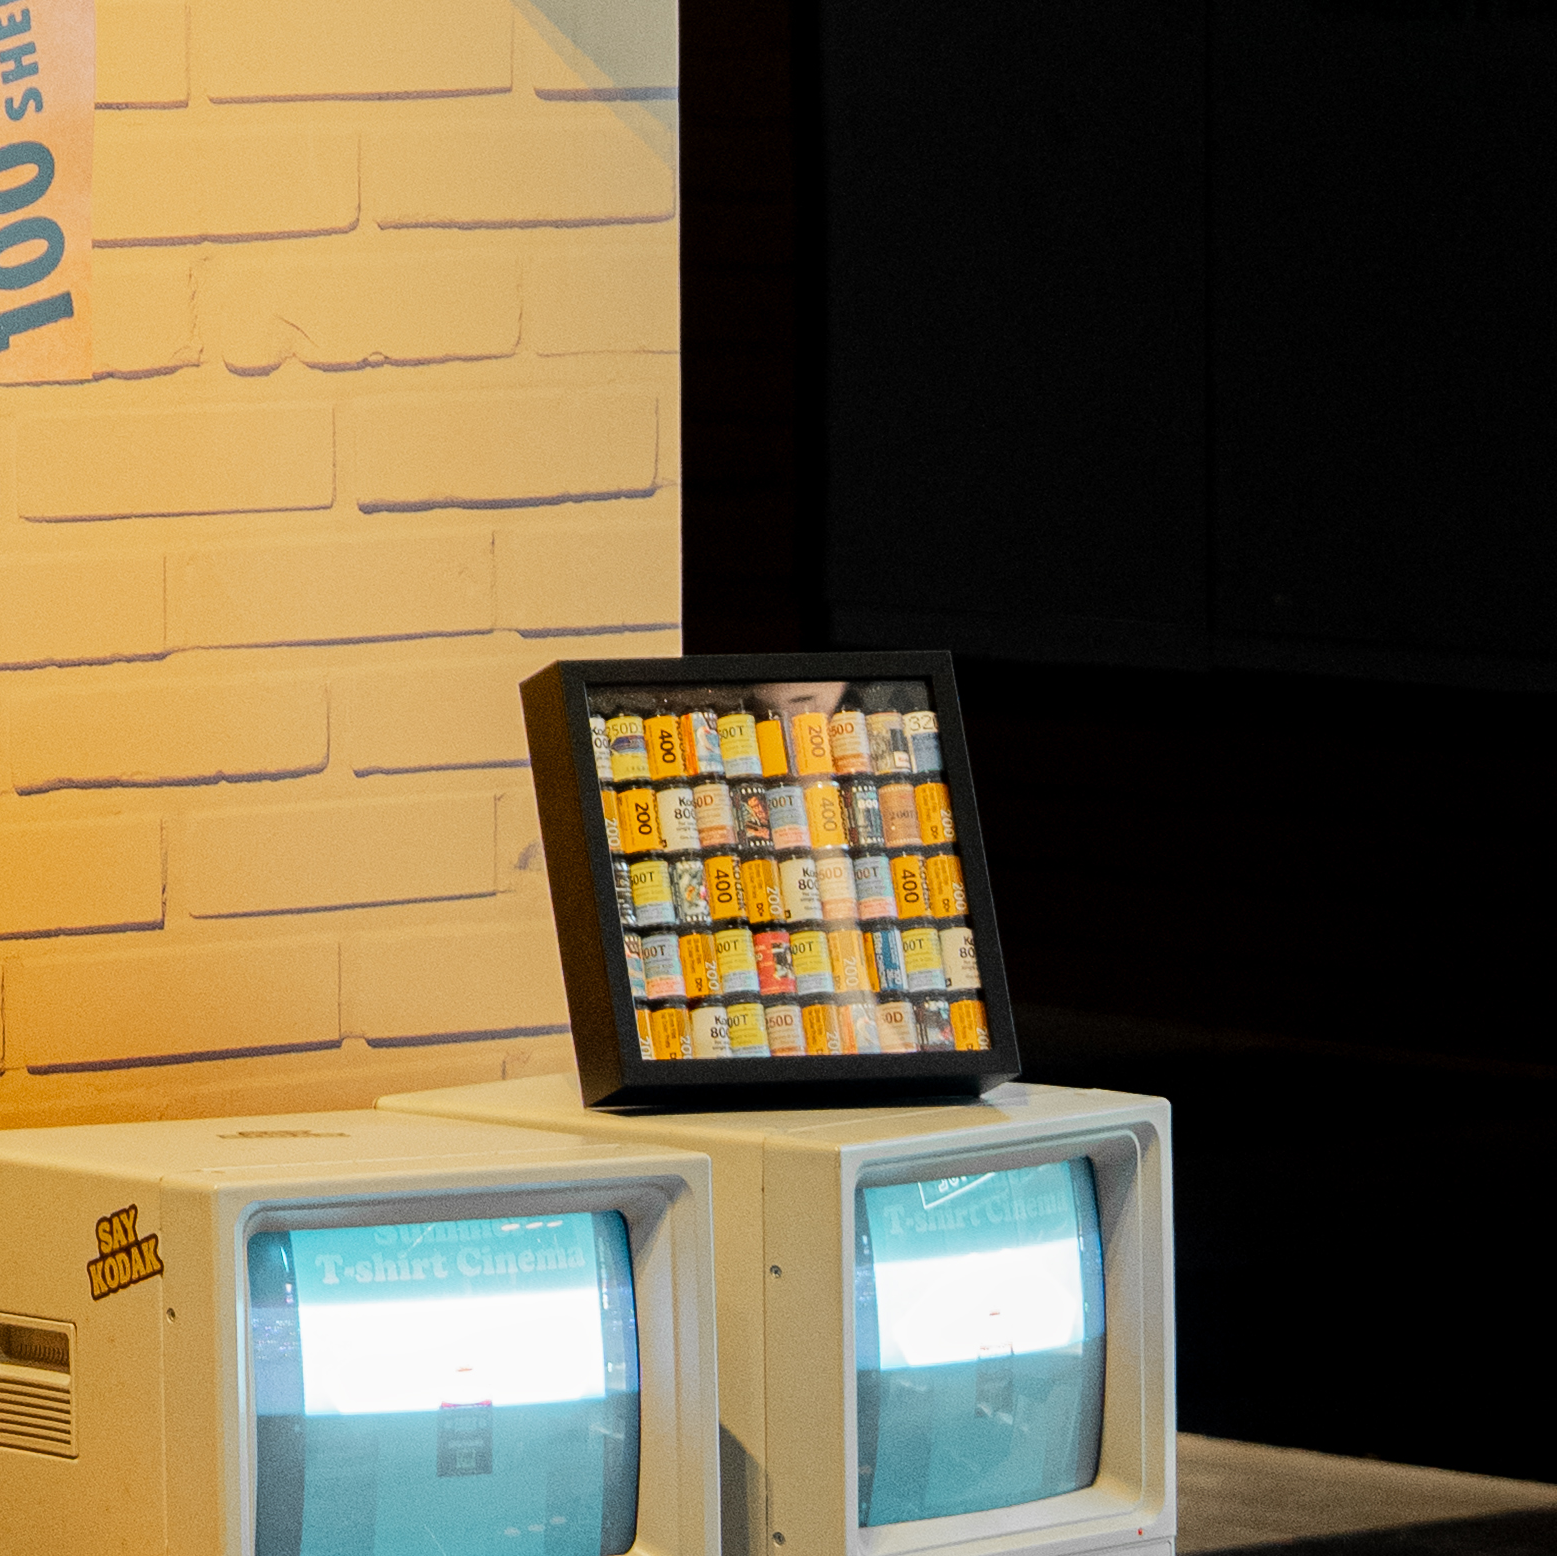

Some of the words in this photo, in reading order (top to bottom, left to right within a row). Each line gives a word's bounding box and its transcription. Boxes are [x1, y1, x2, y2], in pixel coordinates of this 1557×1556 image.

[659, 729, 677, 764] 400
[808, 724, 826, 759] 200
[635, 802, 653, 836] 200
[820, 796, 838, 832] 400
[714, 869, 733, 904] 400
[767, 886, 783, 916] 200
[902, 869, 920, 904] 400
[952, 882, 967, 911] 200
[705, 960, 720, 991] 200
[843, 956, 859, 987] 200
[765, 1014, 794, 1028] 50D
[97, 1205, 138, 1254] SAY
[88, 1236, 162, 1299] KODAK
[315, 1252, 449, 1285] T-shirt
[455, 1245, 586, 1277] Cinema
